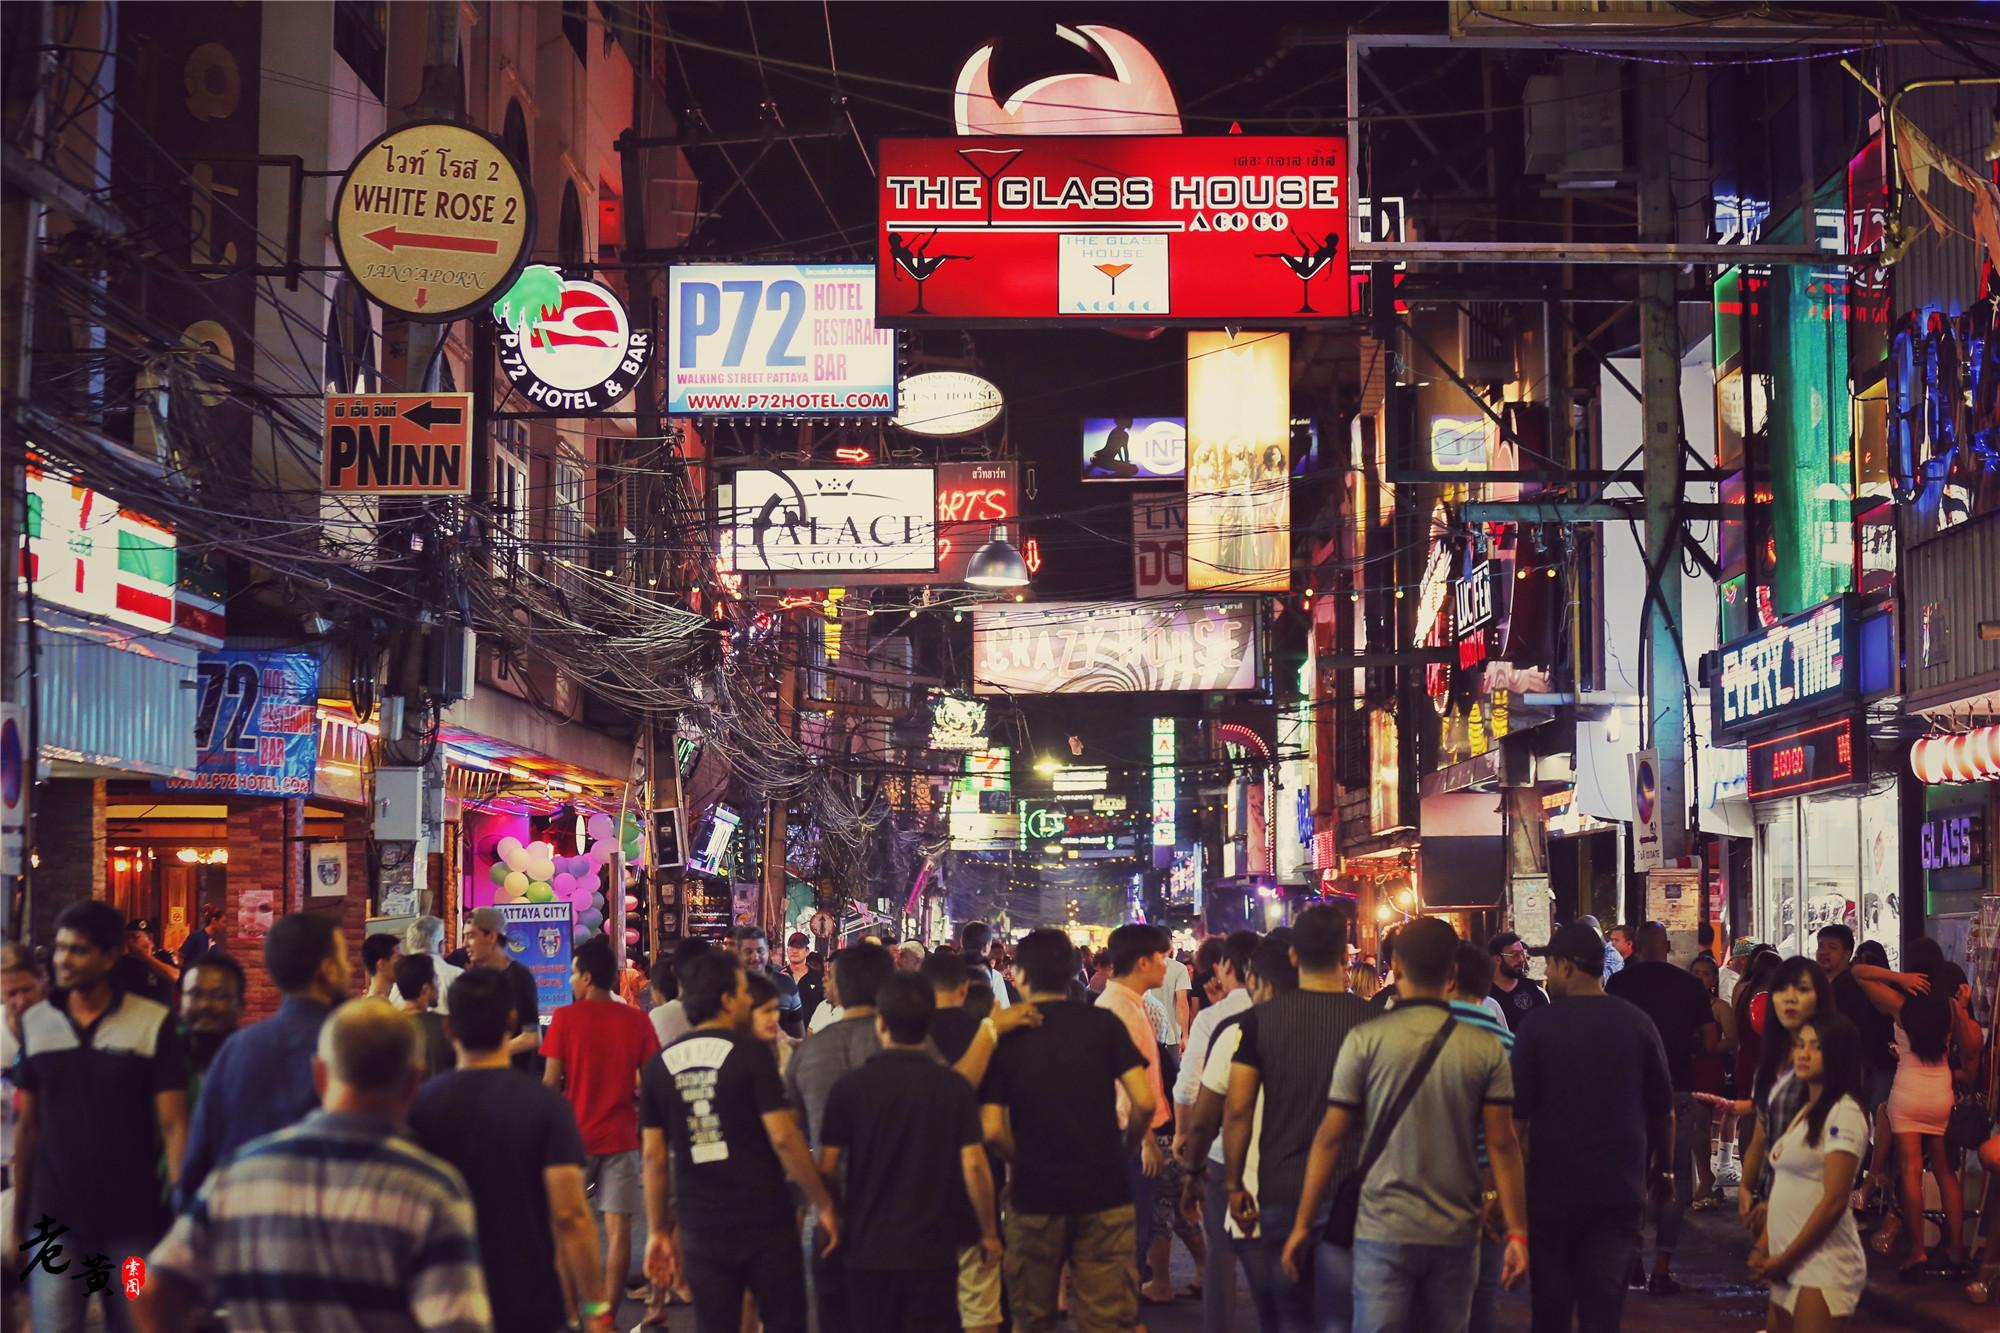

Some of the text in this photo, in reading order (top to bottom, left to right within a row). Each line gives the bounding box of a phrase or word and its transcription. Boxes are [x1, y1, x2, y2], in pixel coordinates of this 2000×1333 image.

[381, 145, 500, 181] ไวท์ โรส 2
[354, 184, 517, 225] WHITE ROSE 2
[886, 175, 1339, 210] THE GLASS HOUSE
[1188, 210, 1212, 232] A
[1063, 236, 1165, 245] THE GLASS
[1082, 249, 1145, 258] HOUSE
[363, 263, 487, 289] JANYAPORN
[814, 283, 863, 311] HOTEL
[680, 279, 806, 368] P72
[500, 333, 648, 410] P.72 HOTEL & BAR
[677, 372, 809, 384] WALKING STREET PATTAYA
[814, 354, 847, 381] BAR
[350, 400, 369, 418] เอ็น
[688, 393, 889, 409] WWW.P72HOTEL.COM
[792, 551, 879, 565] A GO GO
[985, 616, 1243, 678] CRAZY HOUSE
[260, 736, 286, 767] BAR
[1921, 817, 1971, 869] GLASS
[503, 907, 567, 919] ATTAYA CITY
